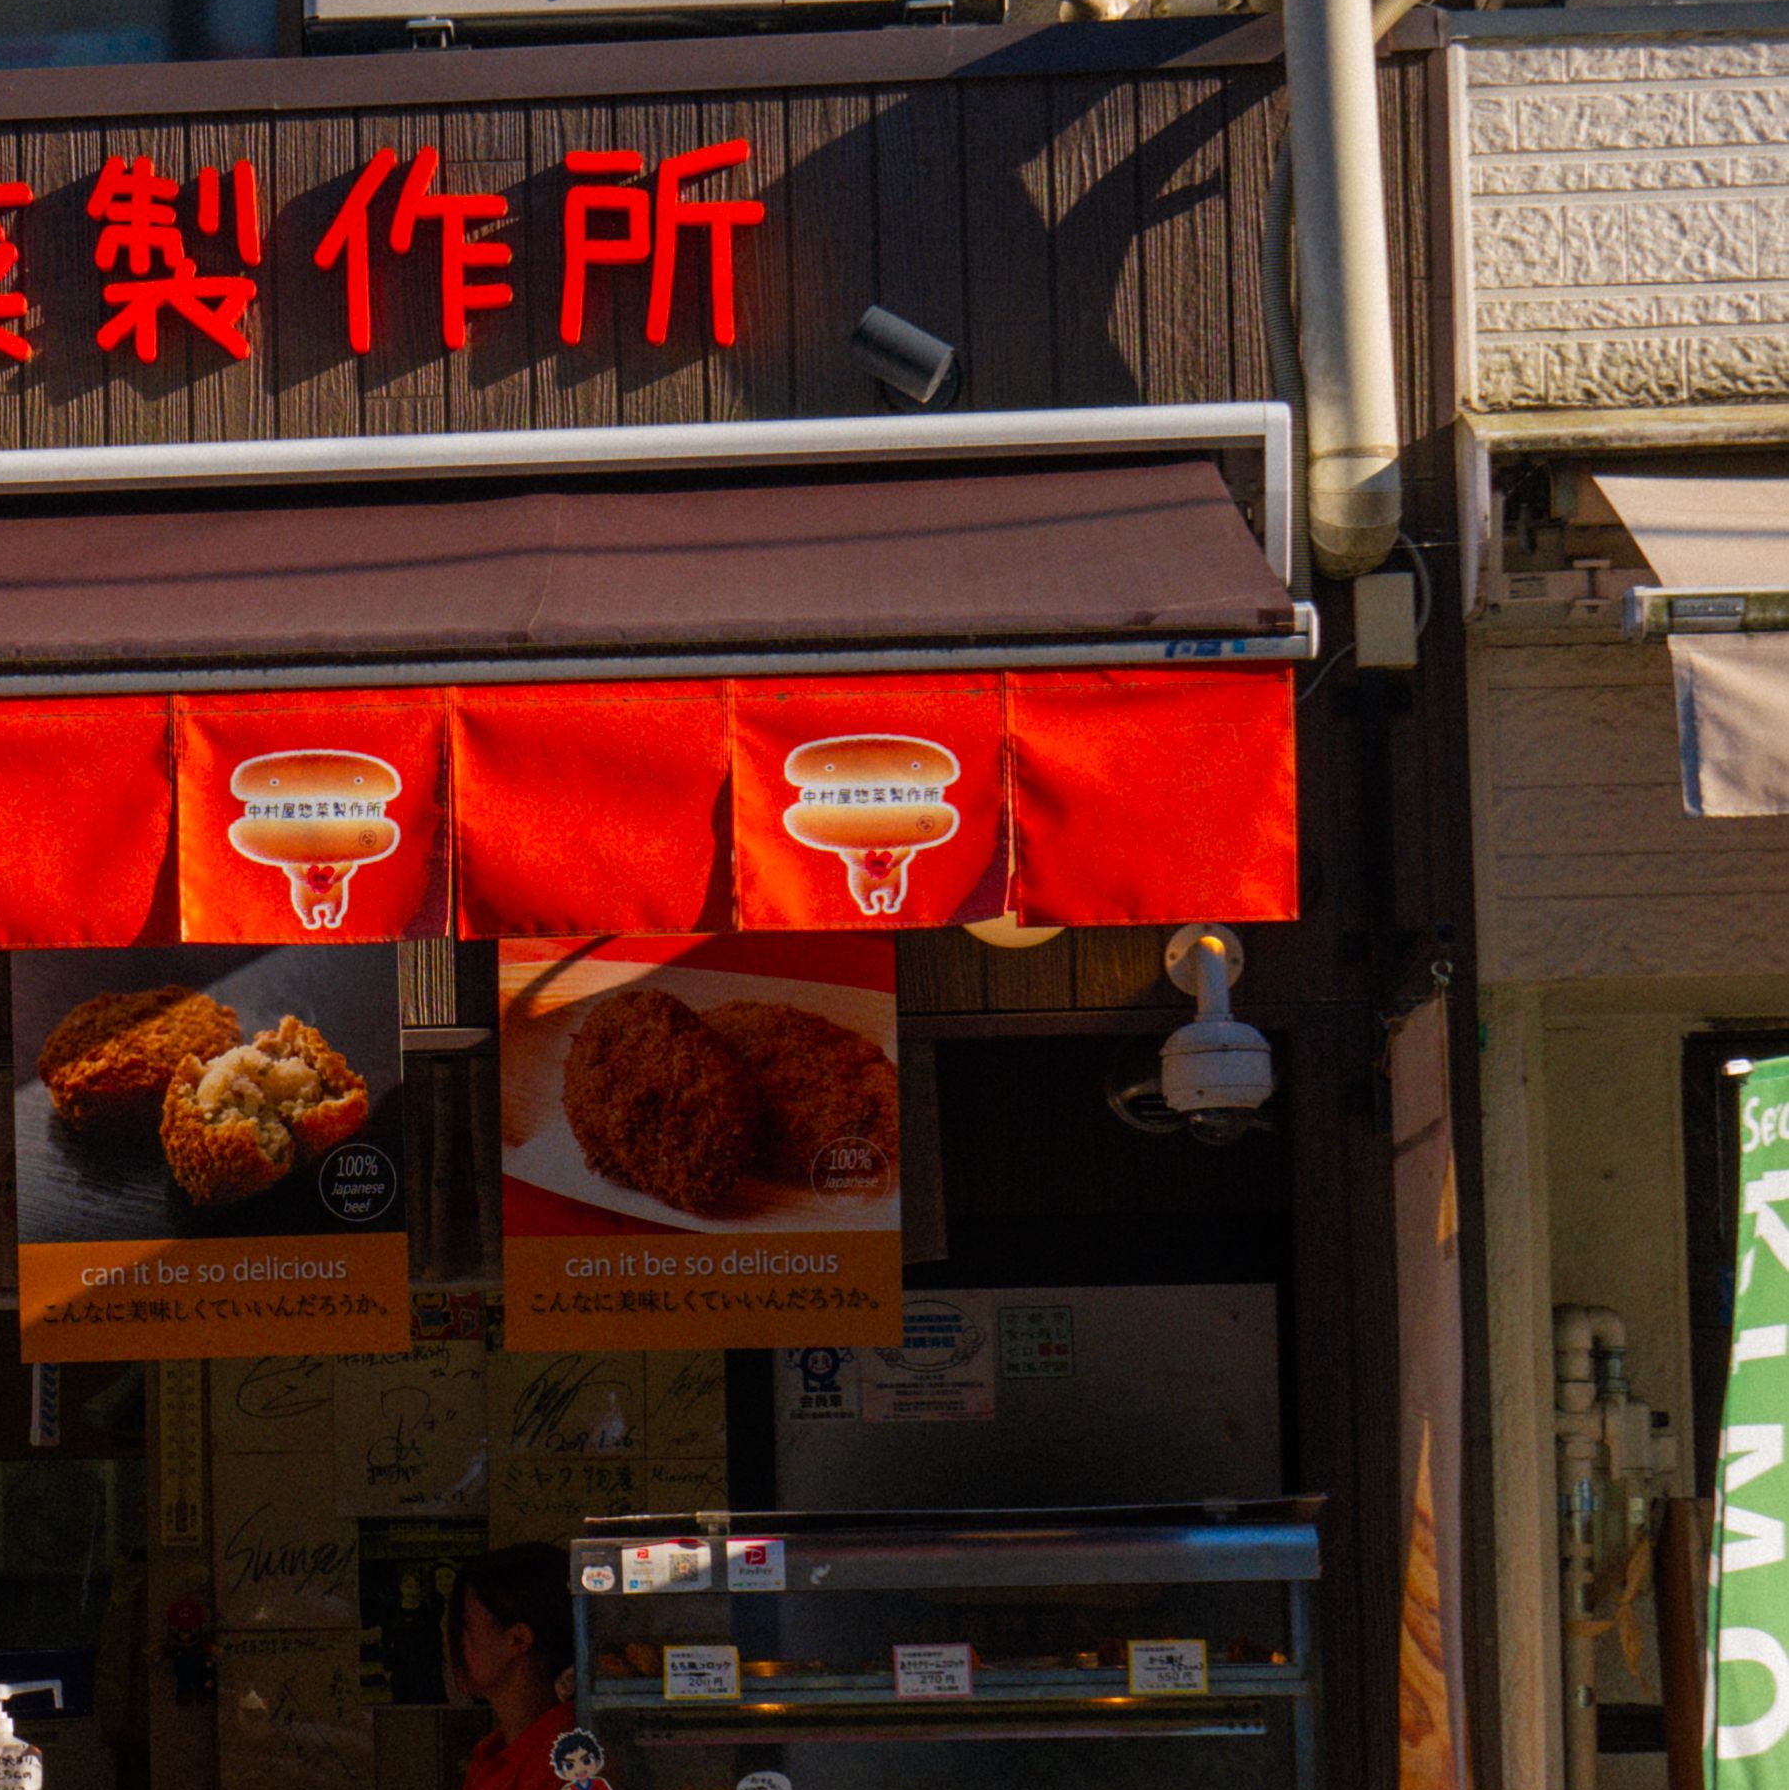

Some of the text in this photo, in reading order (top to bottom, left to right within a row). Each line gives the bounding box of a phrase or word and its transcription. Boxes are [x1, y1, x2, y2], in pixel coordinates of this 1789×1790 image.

[803, 786, 940, 804] 中村屋惣菜製作所
[248, 801, 382, 818] 中村屋惣菜製作所
[337, 1154, 380, 1178] 100%
[829, 1147, 873, 1171] 100%
[331, 1179, 386, 1199] Japanese
[80, 1257, 347, 1286] can it be so delicious
[565, 1248, 839, 1277] can it be so delicious
[920, 1674, 942, 1684] 270
